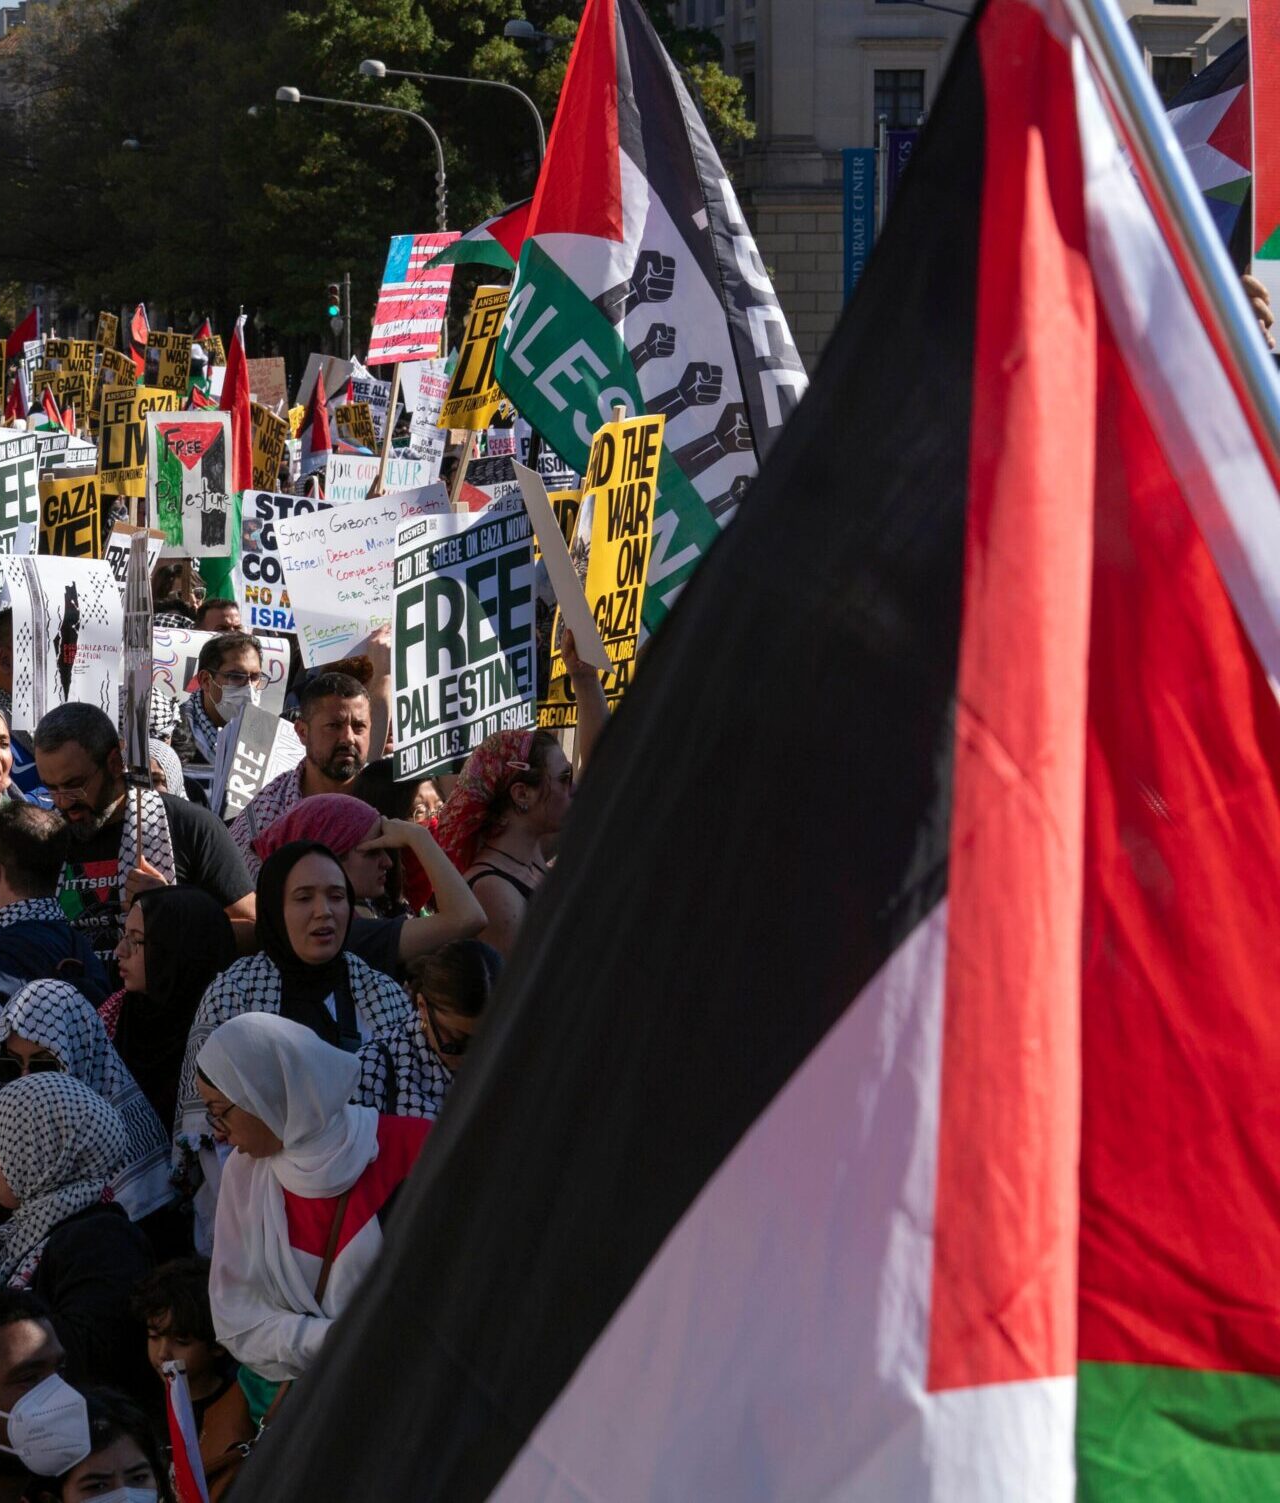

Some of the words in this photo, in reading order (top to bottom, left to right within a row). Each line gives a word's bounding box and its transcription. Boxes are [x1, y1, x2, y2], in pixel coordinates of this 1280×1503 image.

[853, 156, 864, 210] CENTER
[478, 294, 509, 308] ANSWER
[468, 308, 506, 342] LET
[46, 342, 70, 358] END
[74, 343, 94, 359] THE
[147, 333, 168, 349] END
[171, 335, 191, 350] THE
[103, 352, 121, 371] END
[166, 350, 189, 364] WAR
[174, 364, 187, 376] ON
[162, 375, 186, 390] GAZA
[372, 385, 387, 398] ALL
[106, 390, 135, 401] ANSWER
[104, 401, 134, 425] LET
[335, 407, 351, 425] END
[352, 403, 370, 421] THE
[443, 400, 463, 417] STOP
[162, 427, 203, 462] FREE
[621, 423, 659, 483] THE
[101, 471, 117, 484] STOP
[43, 481, 98, 527] GAZA
[607, 481, 651, 543] WAR
[279, 524, 326, 546] Starving
[329, 513, 378, 533] Gazans
[381, 507, 397, 521] to
[399, 522, 426, 545] ANSWER
[326, 547, 366, 563] Defense
[398, 560, 412, 584] END
[415, 551, 430, 575] THE
[433, 536, 463, 569] SIEGE
[466, 533, 478, 557] ON
[481, 525, 503, 550] GAZA
[507, 514, 531, 543] NOW!
[617, 537, 648, 589] ON
[245, 585, 272, 605] NO
[396, 546, 532, 692] FREE
[594, 587, 638, 641] GAZA
[396, 646, 532, 743] PALESTINE!
[401, 750, 419, 775] END
[421, 738, 438, 764] ALL
[440, 729, 464, 758] U.S.
[470, 721, 484, 748] AID
[501, 701, 534, 731] ISRAEL
[227, 741, 267, 810] FREE
[65, 876, 117, 890] ITTSBU
